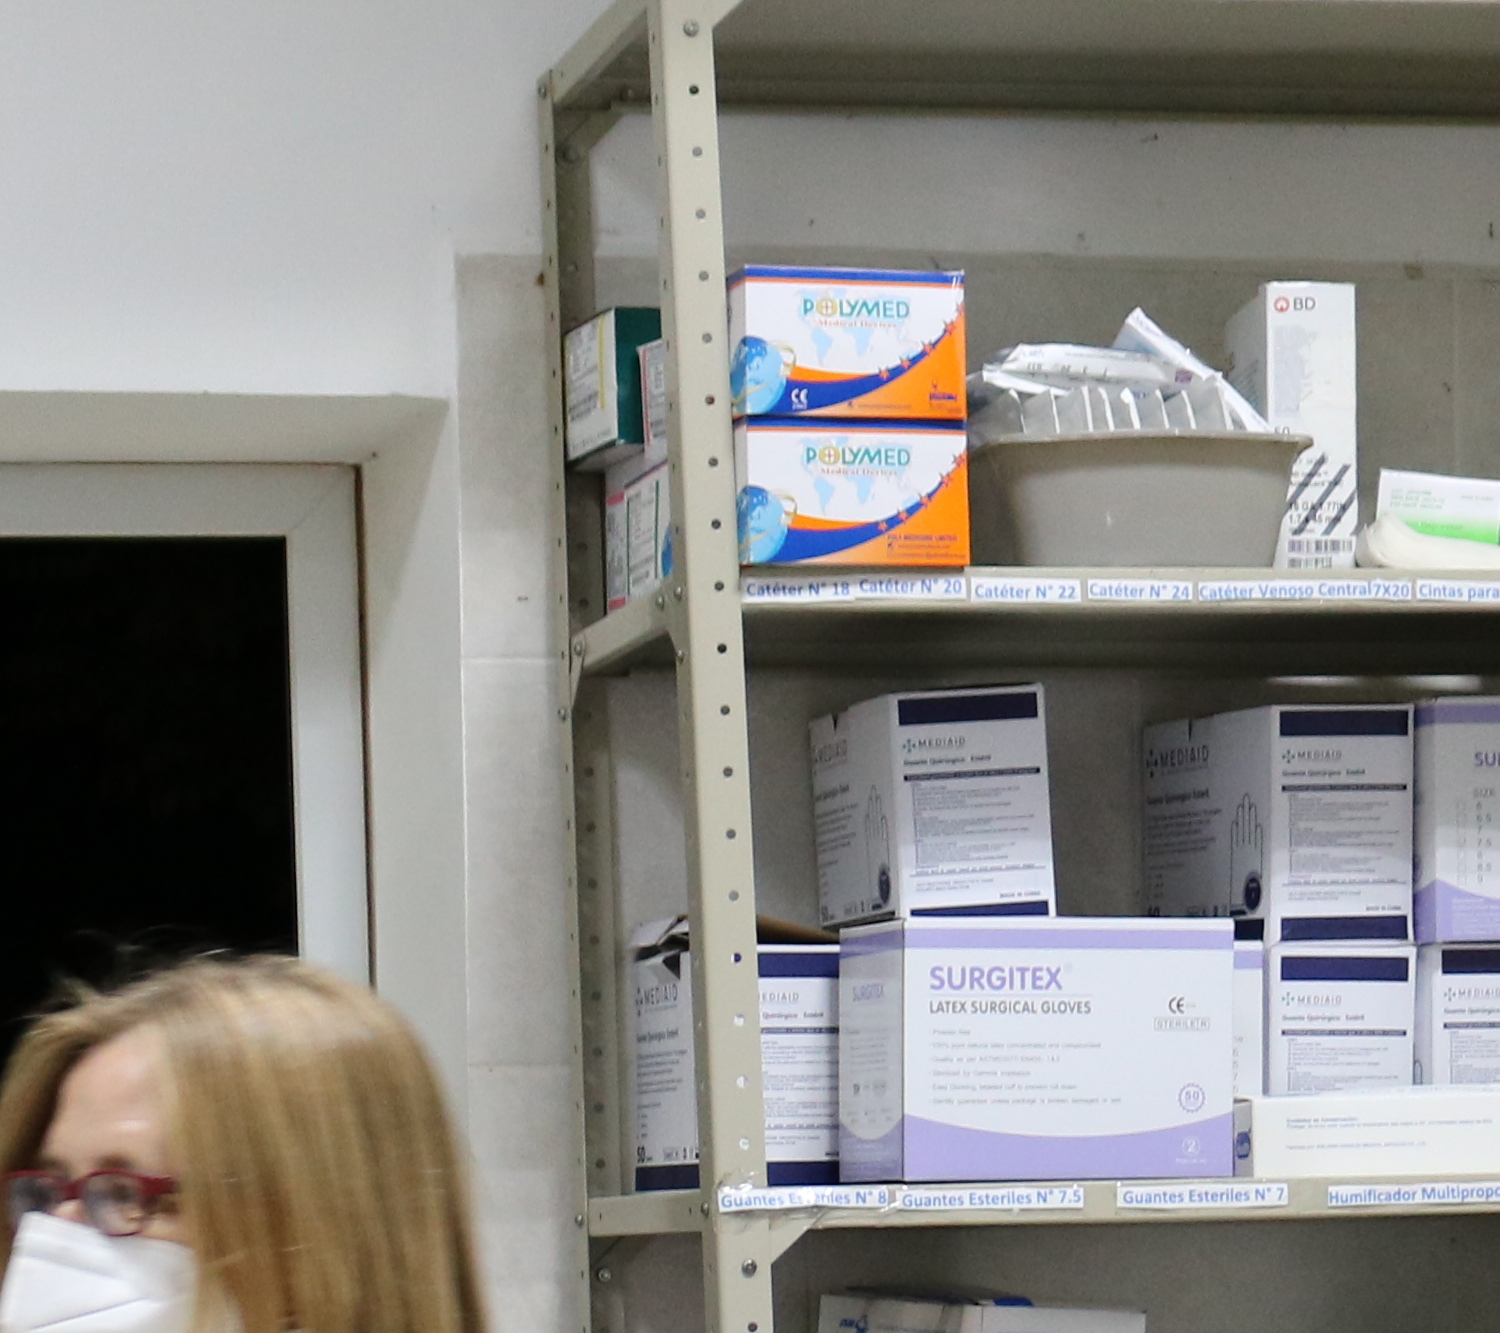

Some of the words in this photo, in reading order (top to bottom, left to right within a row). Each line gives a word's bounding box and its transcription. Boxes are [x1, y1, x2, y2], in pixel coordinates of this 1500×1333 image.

[803, 298, 909, 319] POLYMED
[1293, 297, 1316, 311] BD
[806, 447, 911, 467] POLYMED
[747, 582, 802, 597] Catéter
[834, 583, 850, 596] 18
[859, 577, 915, 592] Catéter
[944, 580, 962, 593] 20
[975, 583, 1030, 598] Catéter
[1058, 586, 1076, 599] 22
[1089, 582, 1144, 597] Catéter
[1172, 584, 1190, 598] 24
[1200, 584, 1254, 599] Catéter
[1258, 584, 1313, 598] Venoso
[1419, 584, 1463, 598] Cintas
[1468, 587, 1500, 601] para
[918, 736, 966, 748] MEDIAID
[1159, 744, 1210, 768] MEDIAID
[1297, 749, 1342, 762] MEDIAID
[929, 965, 1063, 991] SURGITEX
[930, 1001, 967, 1014] LATEX
[971, 1001, 1037, 1014] SURGICAL
[1041, 1000, 1092, 1014] GLOVES
[1297, 993, 1342, 1006] MEDIAID
[721, 1195, 791, 1209] Guantes
[902, 1193, 964, 1208] Guantes
[969, 1190, 1031, 1206] Esteriles
[1059, 1189, 1081, 1204] 7.5
[1123, 1190, 1184, 1206] Guantes
[1188, 1188, 1250, 1204] Esteriles
[1329, 1188, 1417, 1205] Humificador
